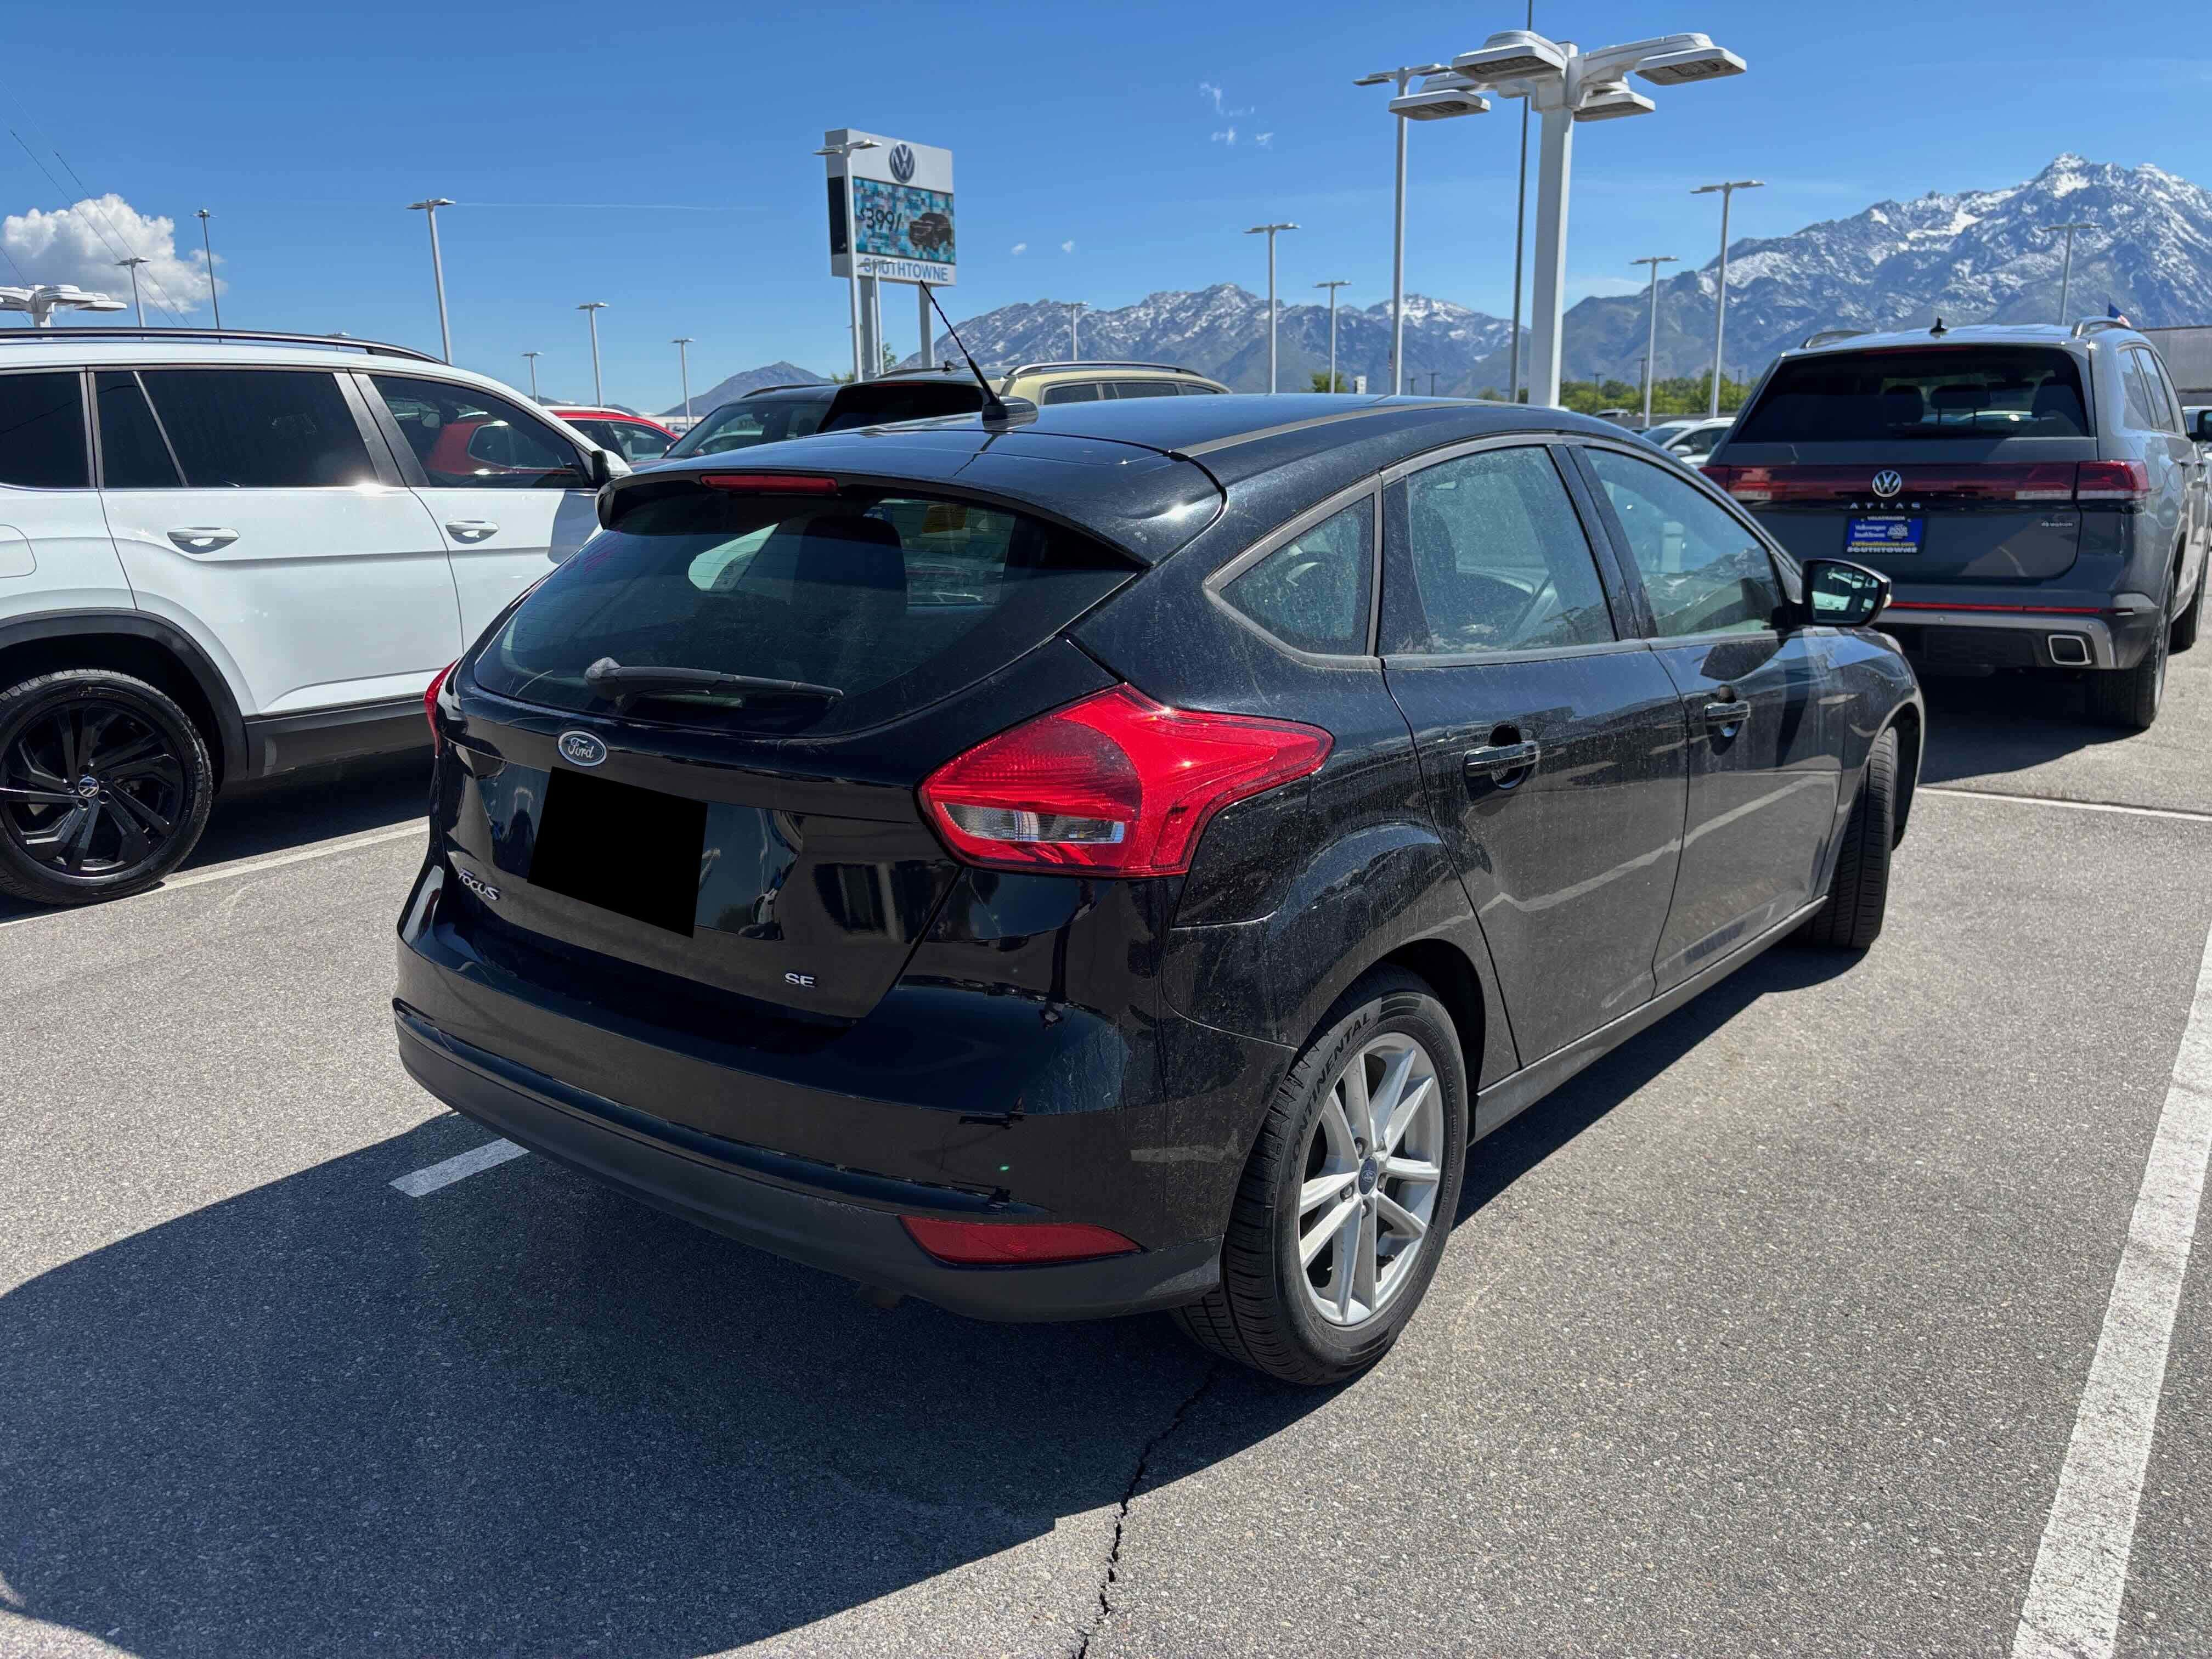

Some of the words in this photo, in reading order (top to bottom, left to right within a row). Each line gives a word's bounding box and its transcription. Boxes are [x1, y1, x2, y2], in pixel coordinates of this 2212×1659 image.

[864, 257, 948, 281] SUTHTOWNE
[567, 737, 595, 759] Ford
[785, 973, 815, 988] SE
